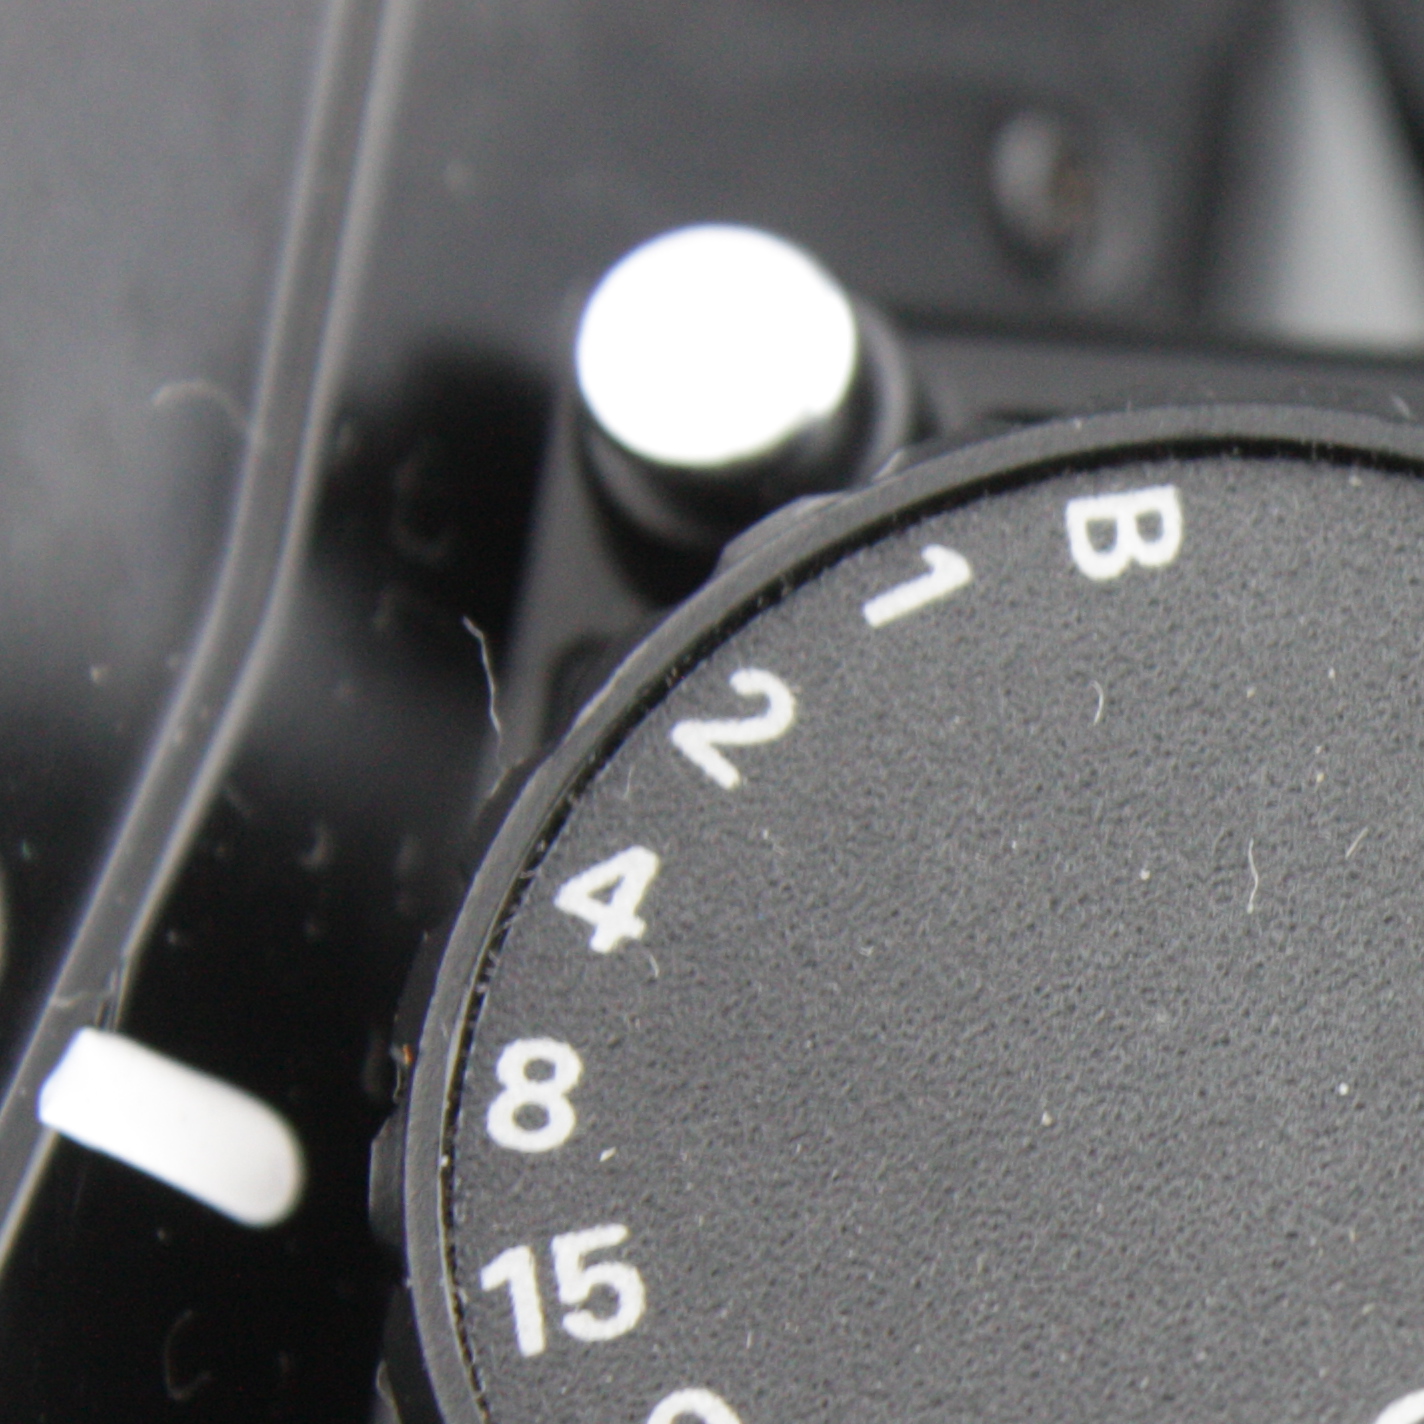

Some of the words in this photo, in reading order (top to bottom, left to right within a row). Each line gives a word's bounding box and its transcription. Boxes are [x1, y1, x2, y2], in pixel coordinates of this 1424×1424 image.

[861, 543, 973, 628] 1
[1064, 484, 1184, 581] B
[669, 666, 797, 790] 2
[553, 845, 660, 954] 4
[485, 1037, 583, 1153] 8
[479, 1223, 646, 1357] 15
